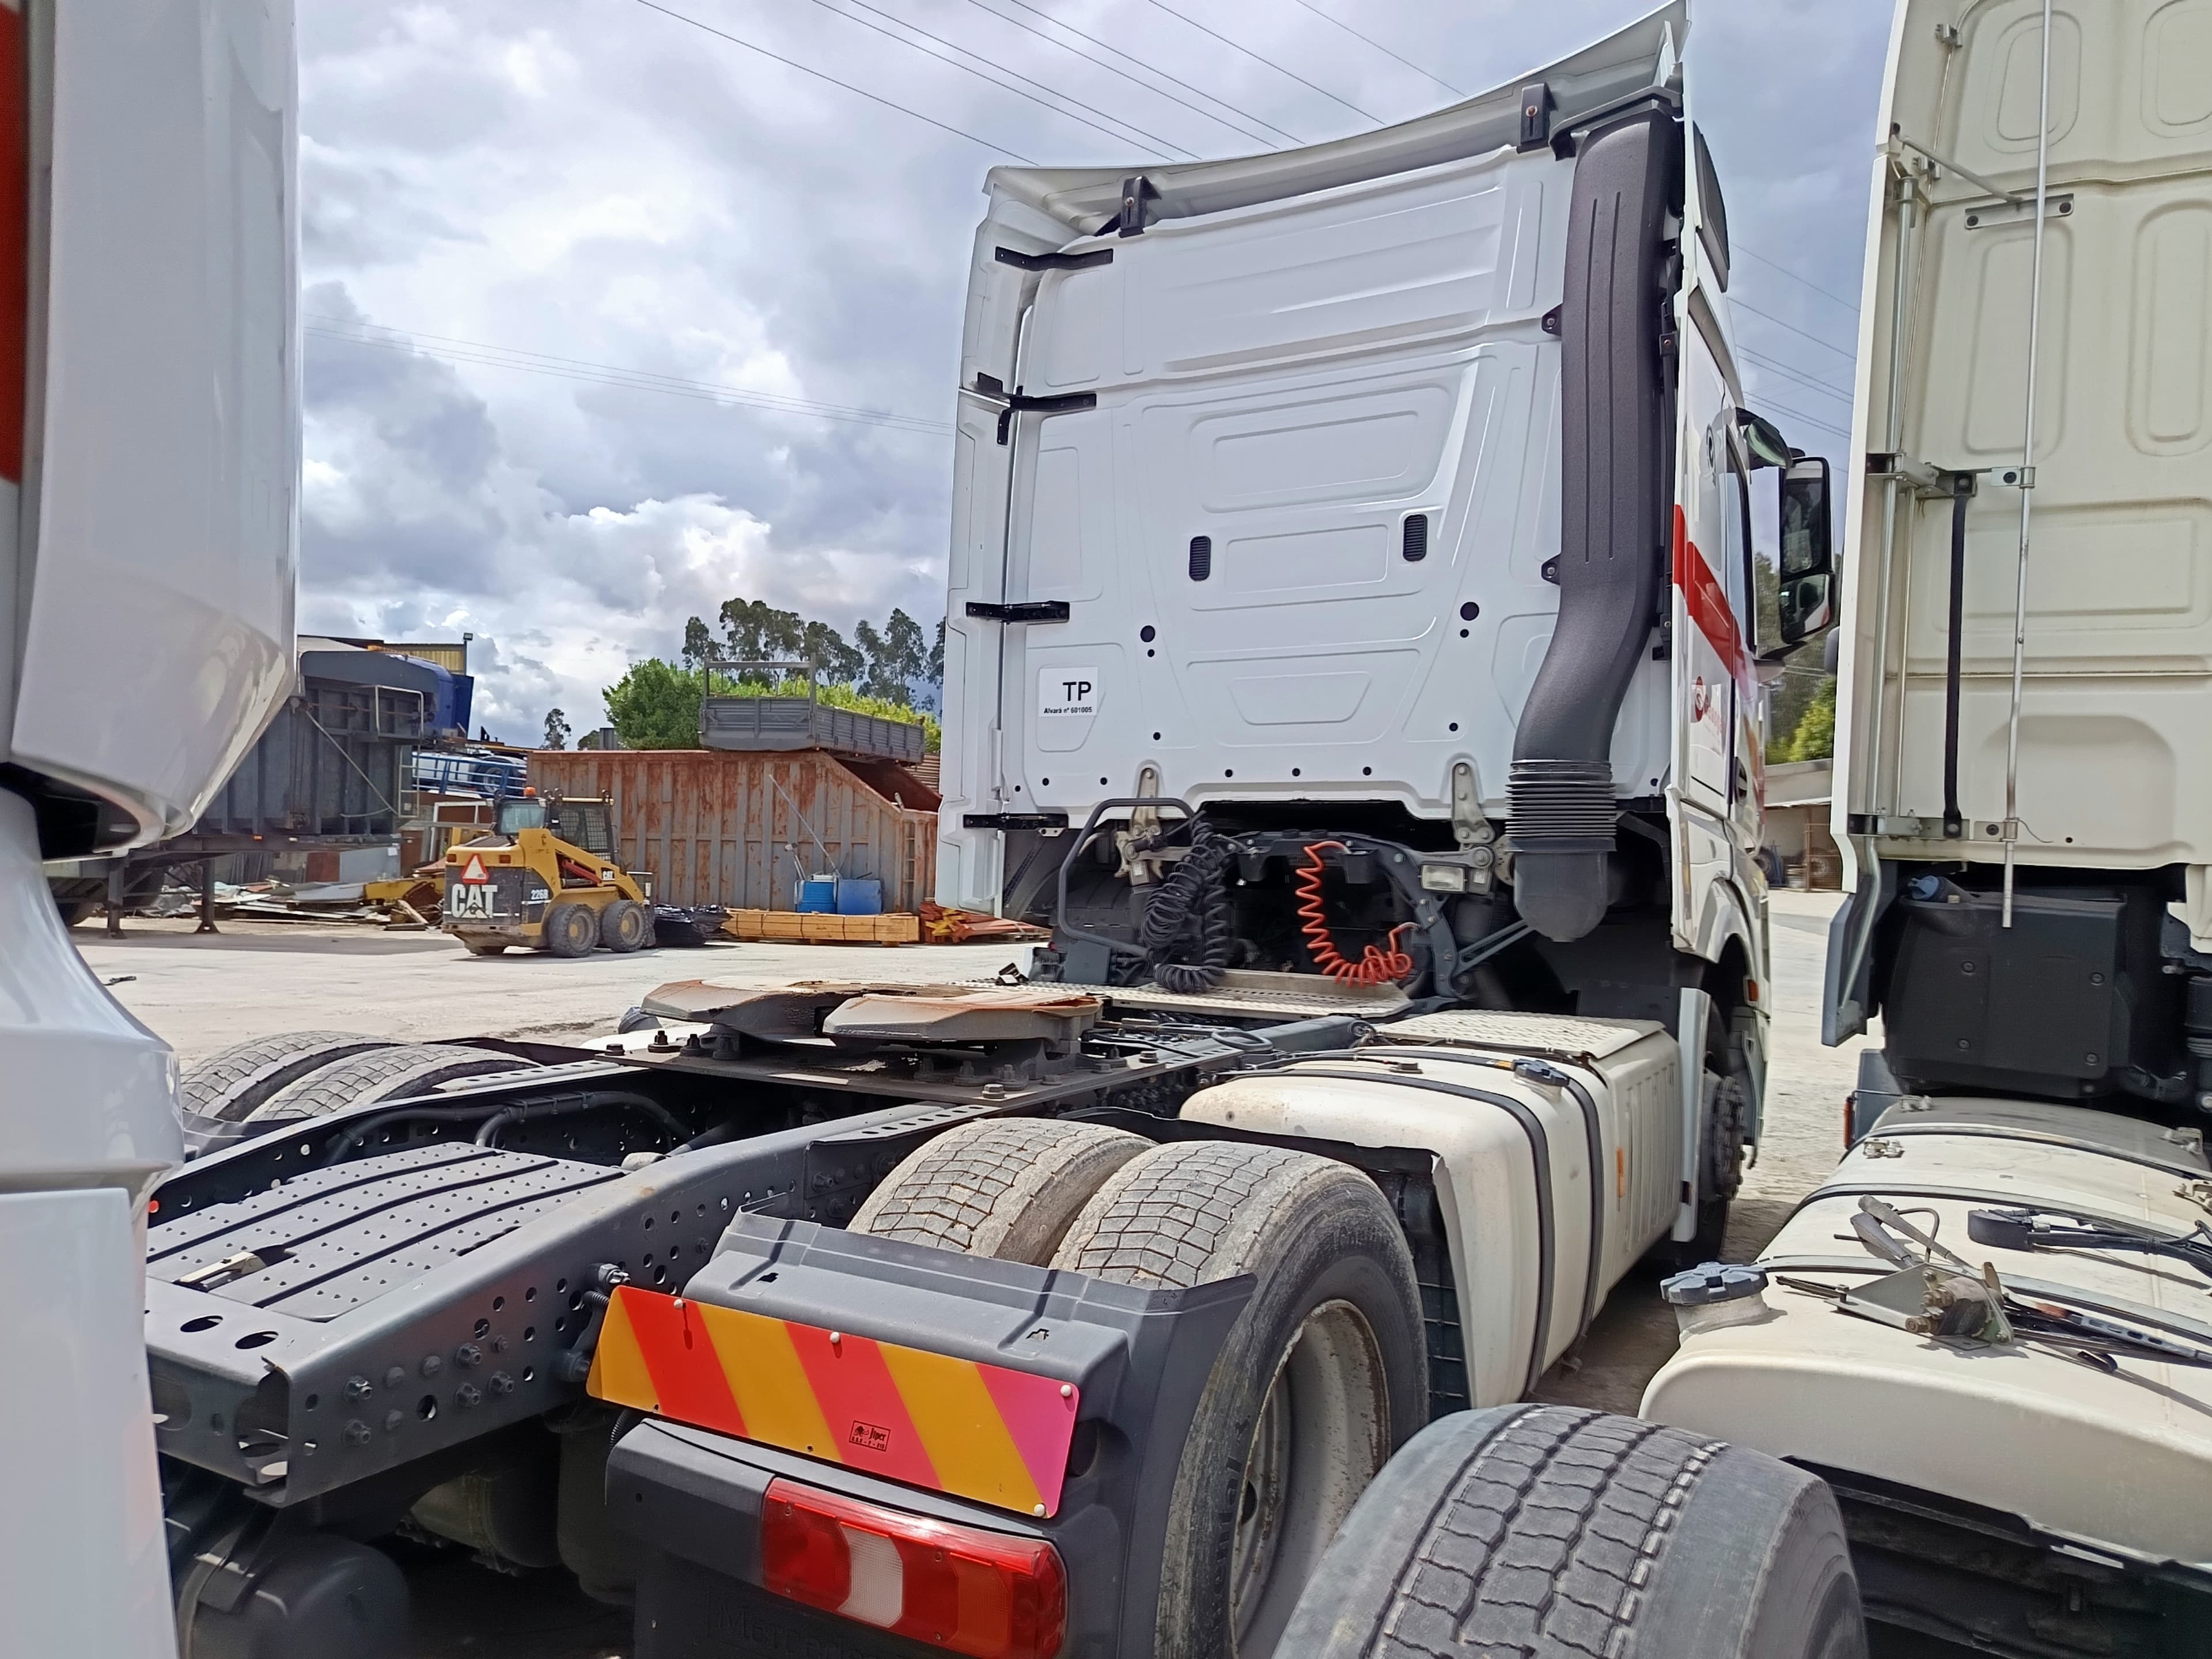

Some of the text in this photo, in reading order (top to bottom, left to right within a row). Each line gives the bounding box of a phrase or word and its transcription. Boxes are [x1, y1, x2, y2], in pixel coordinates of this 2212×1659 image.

[1062, 681, 1092, 702] TP
[603, 870, 613, 880] CAT
[452, 883, 498, 919] CAT
